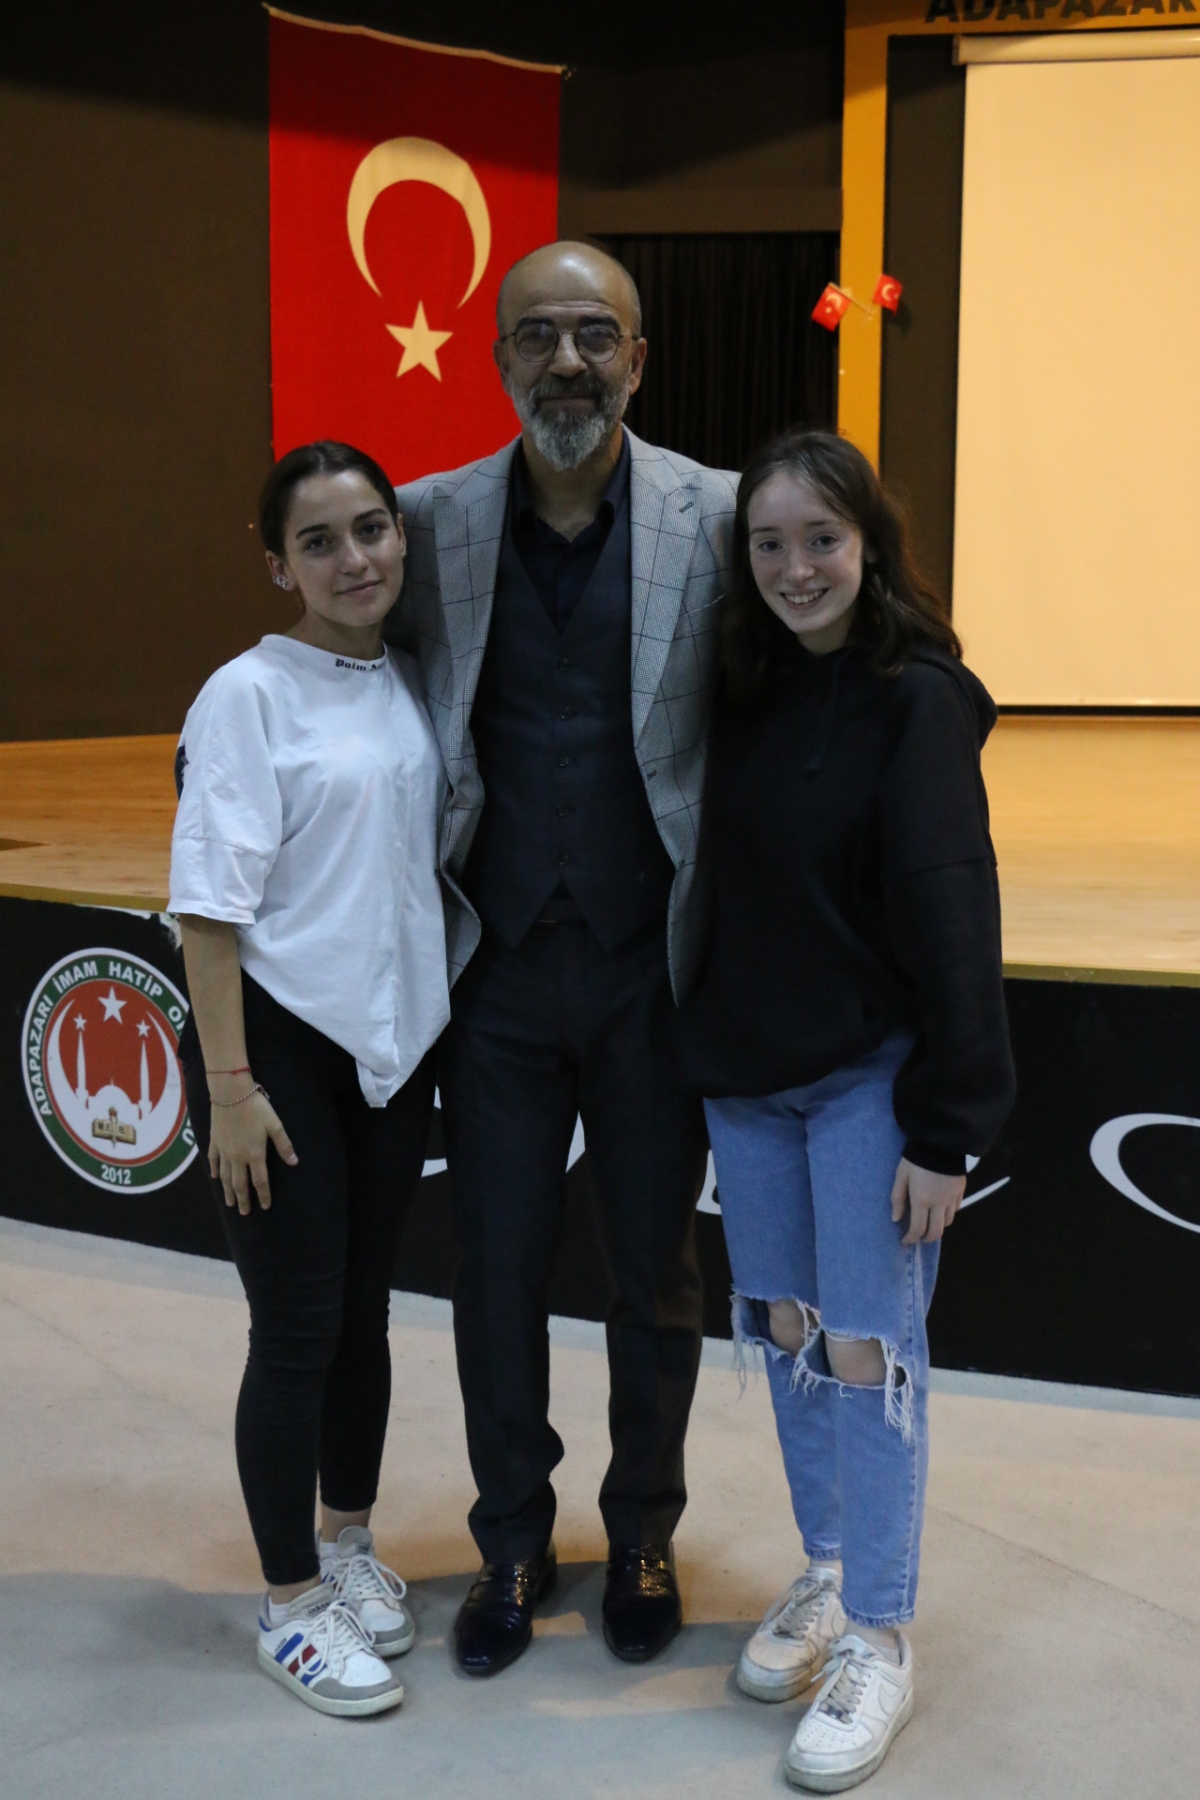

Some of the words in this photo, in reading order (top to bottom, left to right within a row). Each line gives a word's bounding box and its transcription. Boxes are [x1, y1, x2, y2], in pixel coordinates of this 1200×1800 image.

[29, 994, 54, 1115] ADAPAZARI
[52, 960, 98, 994] İMAM
[108, 961, 163, 997] HATİP
[101, 1164, 131, 1185] 2012
